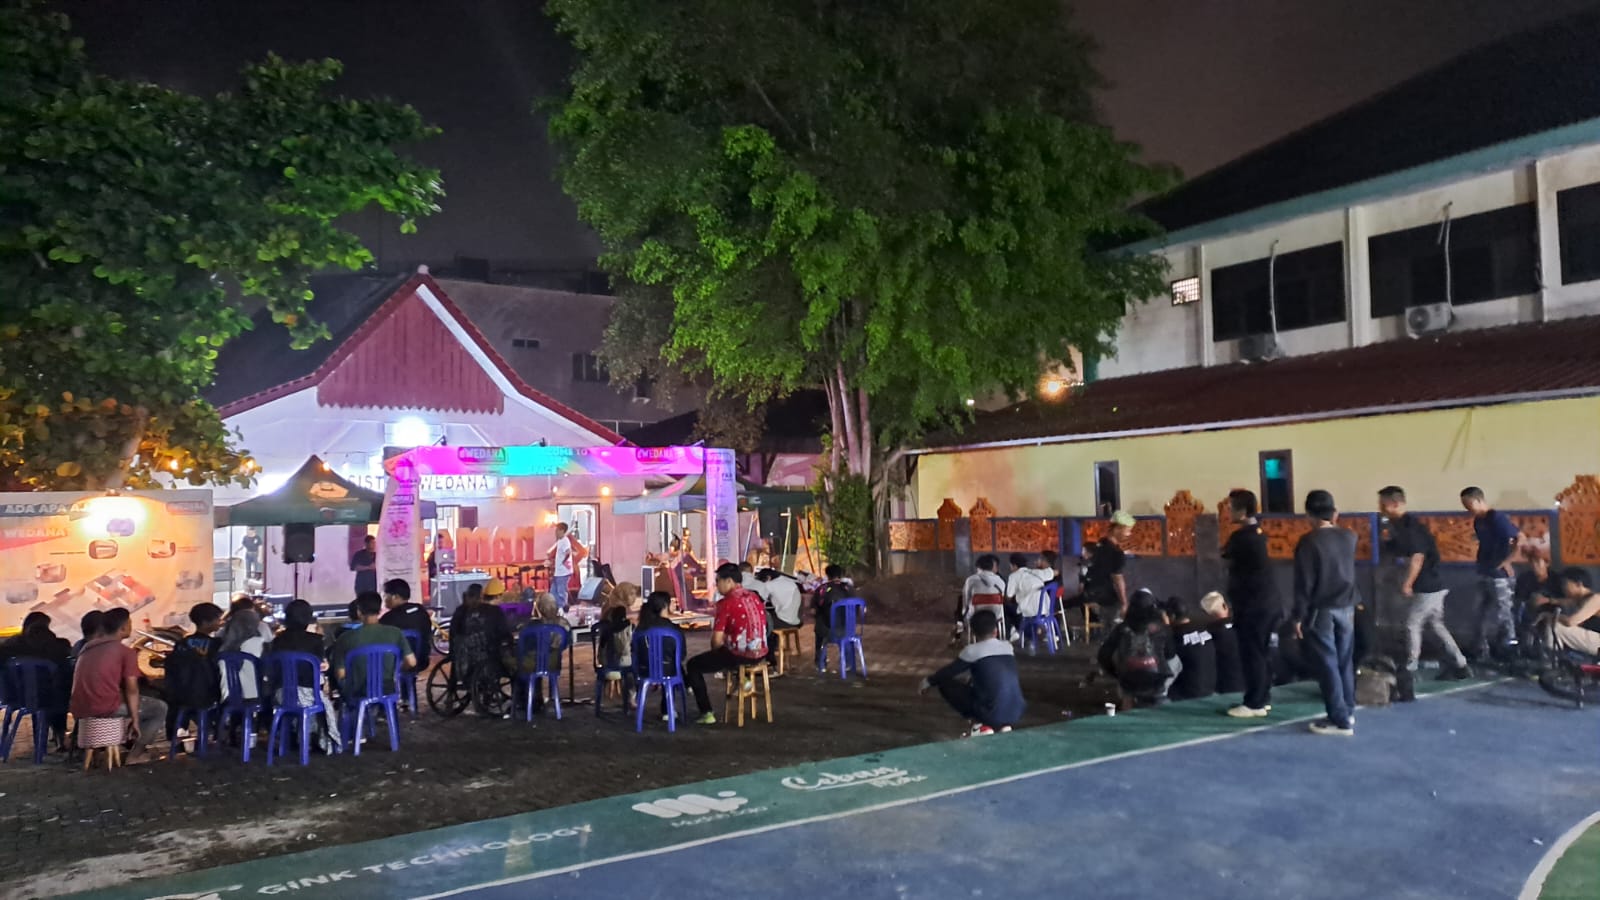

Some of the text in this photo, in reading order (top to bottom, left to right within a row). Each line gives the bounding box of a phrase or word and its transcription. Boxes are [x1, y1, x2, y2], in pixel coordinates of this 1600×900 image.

[5, 504, 35, 513] ADA
[39, 503, 67, 513] APA
[4, 528, 66, 538] WEDANA
[257, 824, 592, 894] GINK TECHNOLOGY
